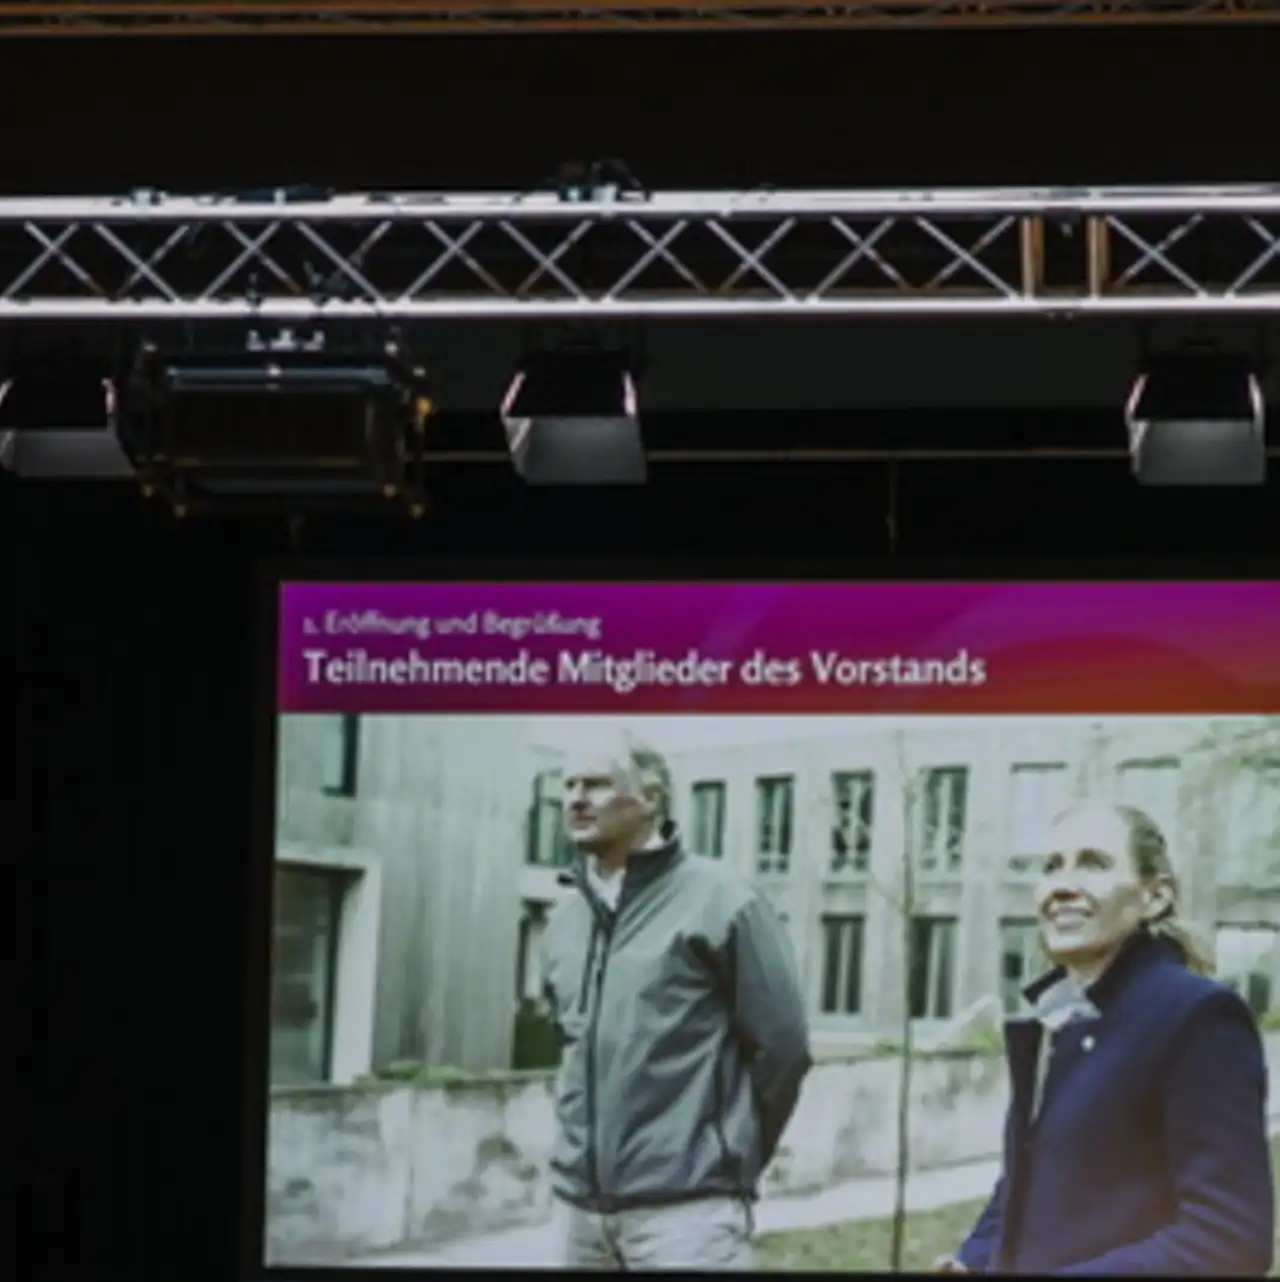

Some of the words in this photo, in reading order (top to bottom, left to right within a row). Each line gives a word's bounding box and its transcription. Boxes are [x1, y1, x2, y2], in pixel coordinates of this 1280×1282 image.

[325, 609, 431, 640] Eröffnung
[434, 611, 477, 635] und
[482, 608, 602, 640] Begrüßung
[303, 649, 550, 684] Teilnehmende
[557, 649, 731, 693] Mitglieder
[740, 649, 801, 686] des
[810, 649, 987, 686] Vorstands
